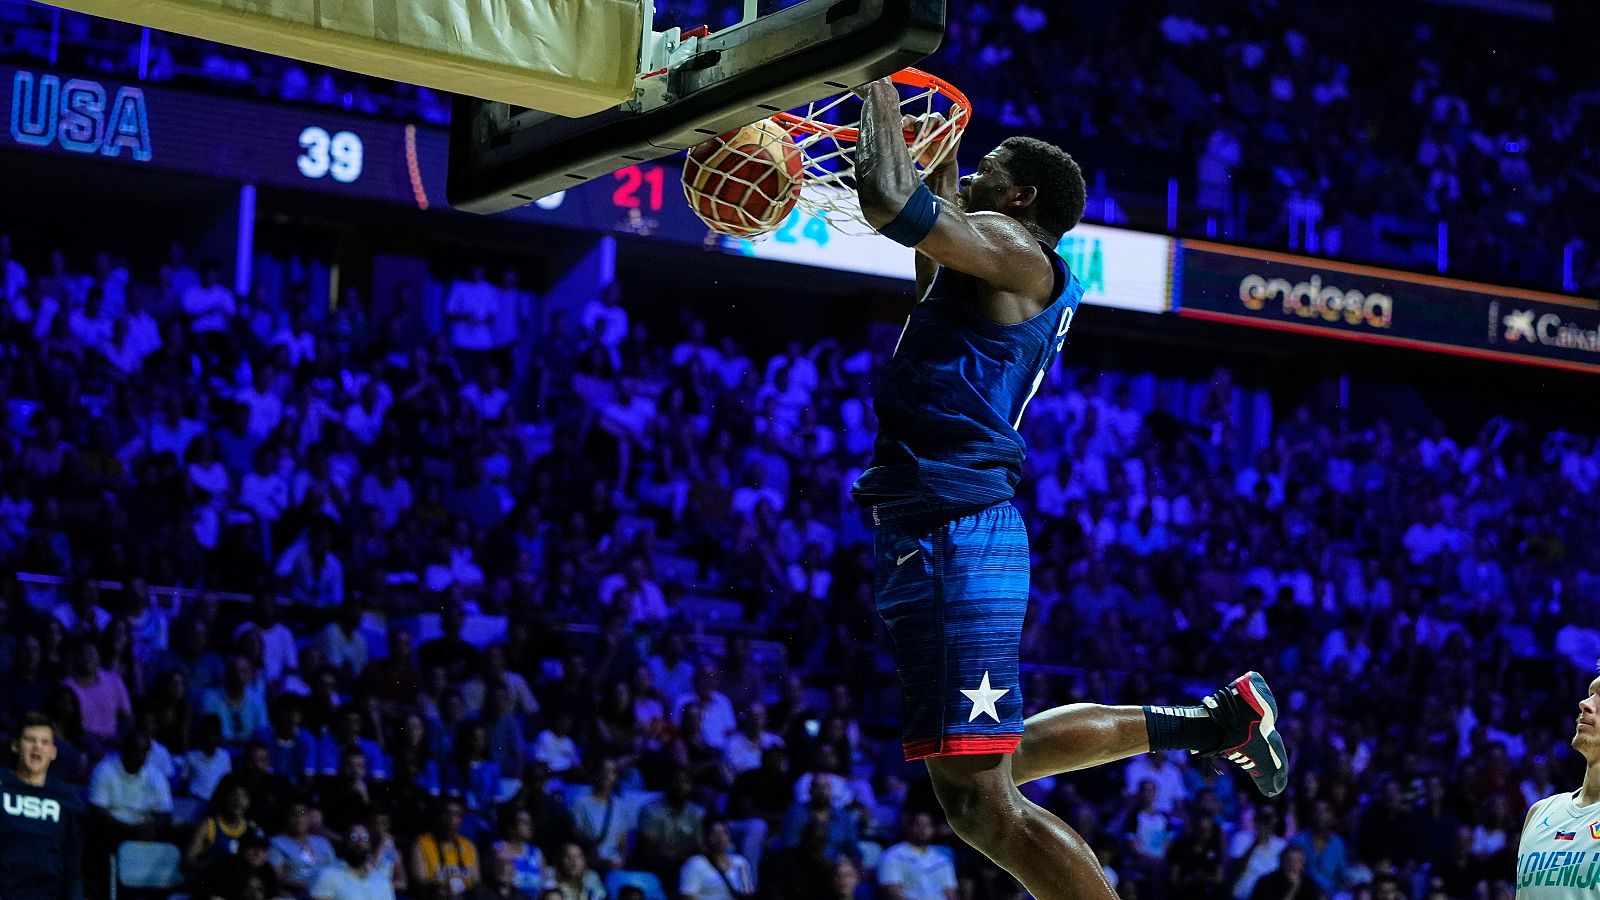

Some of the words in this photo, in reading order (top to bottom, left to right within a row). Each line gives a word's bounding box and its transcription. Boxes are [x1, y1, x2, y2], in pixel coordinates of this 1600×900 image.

[10, 71, 152, 162] USA
[297, 126, 364, 183] 39
[612, 164, 665, 211] 21
[1239, 274, 1393, 329] endesa
[3, 792, 61, 823] USA
